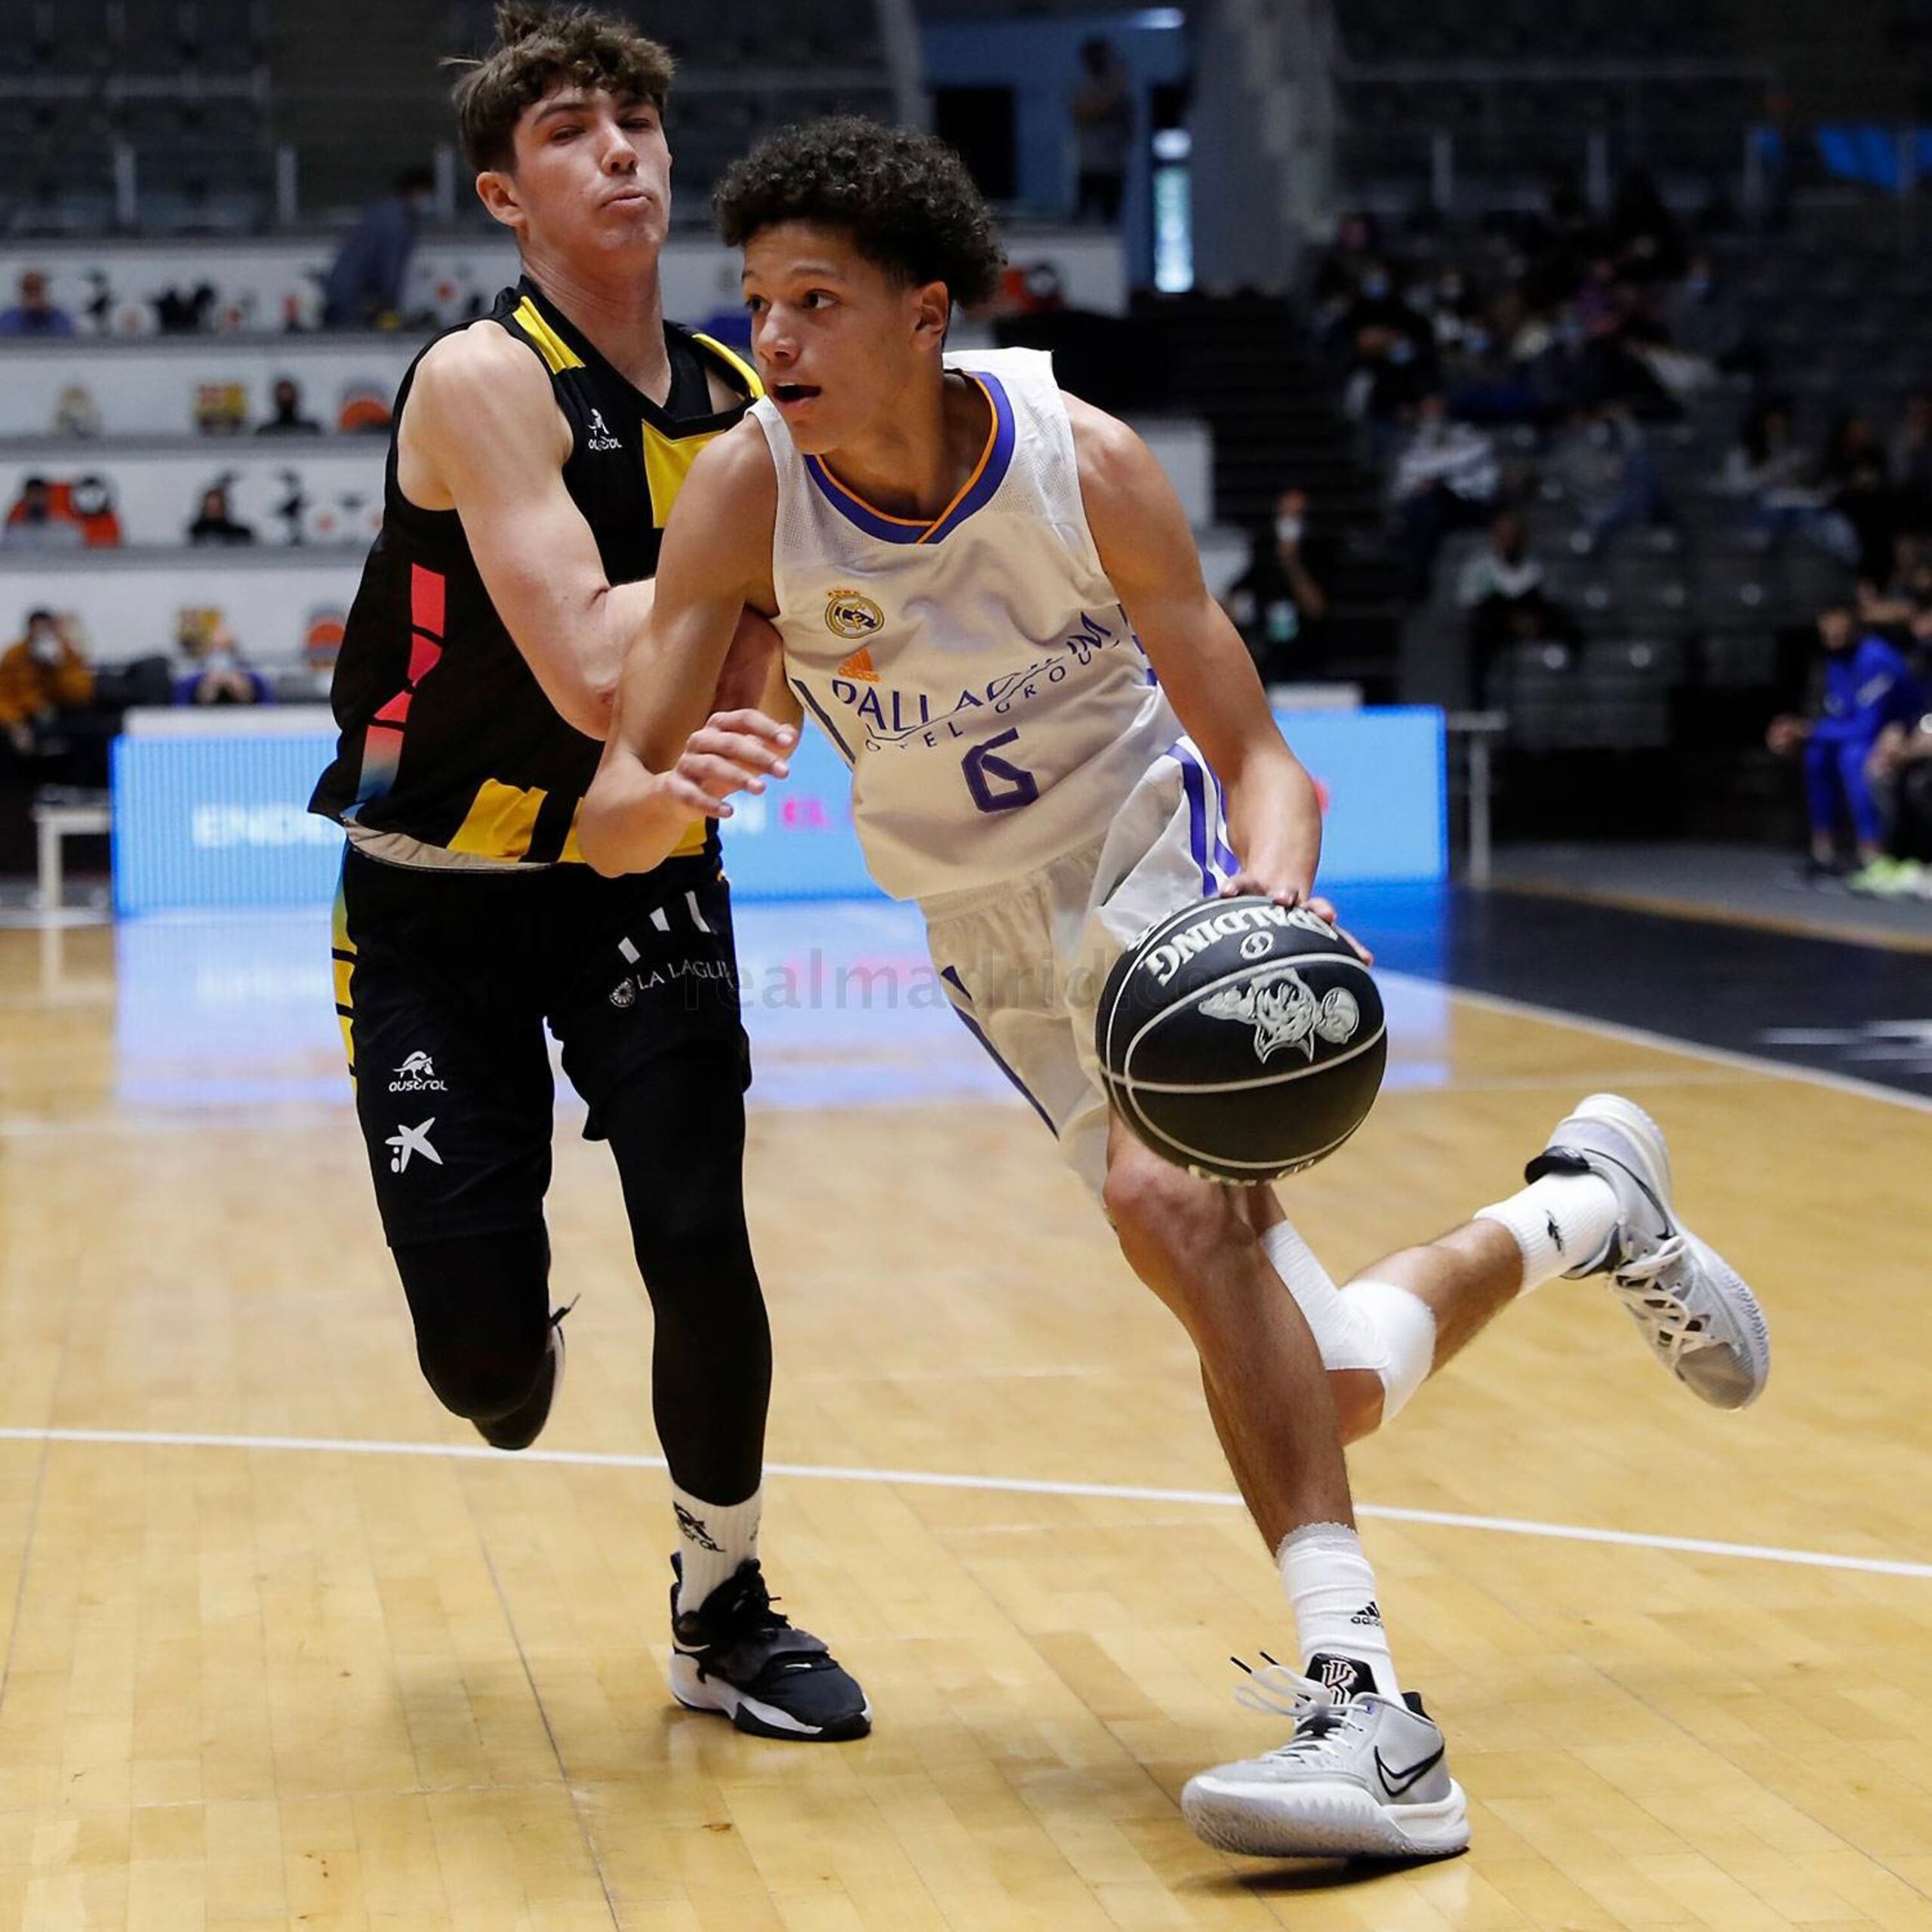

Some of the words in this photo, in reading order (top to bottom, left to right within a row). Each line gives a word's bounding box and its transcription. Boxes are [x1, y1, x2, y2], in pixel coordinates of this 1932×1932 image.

[995, 640, 1120, 714] GROU
[961, 727, 1039, 814] 6
[636, 971, 666, 990] LA
[389, 1080, 449, 1093] austral
